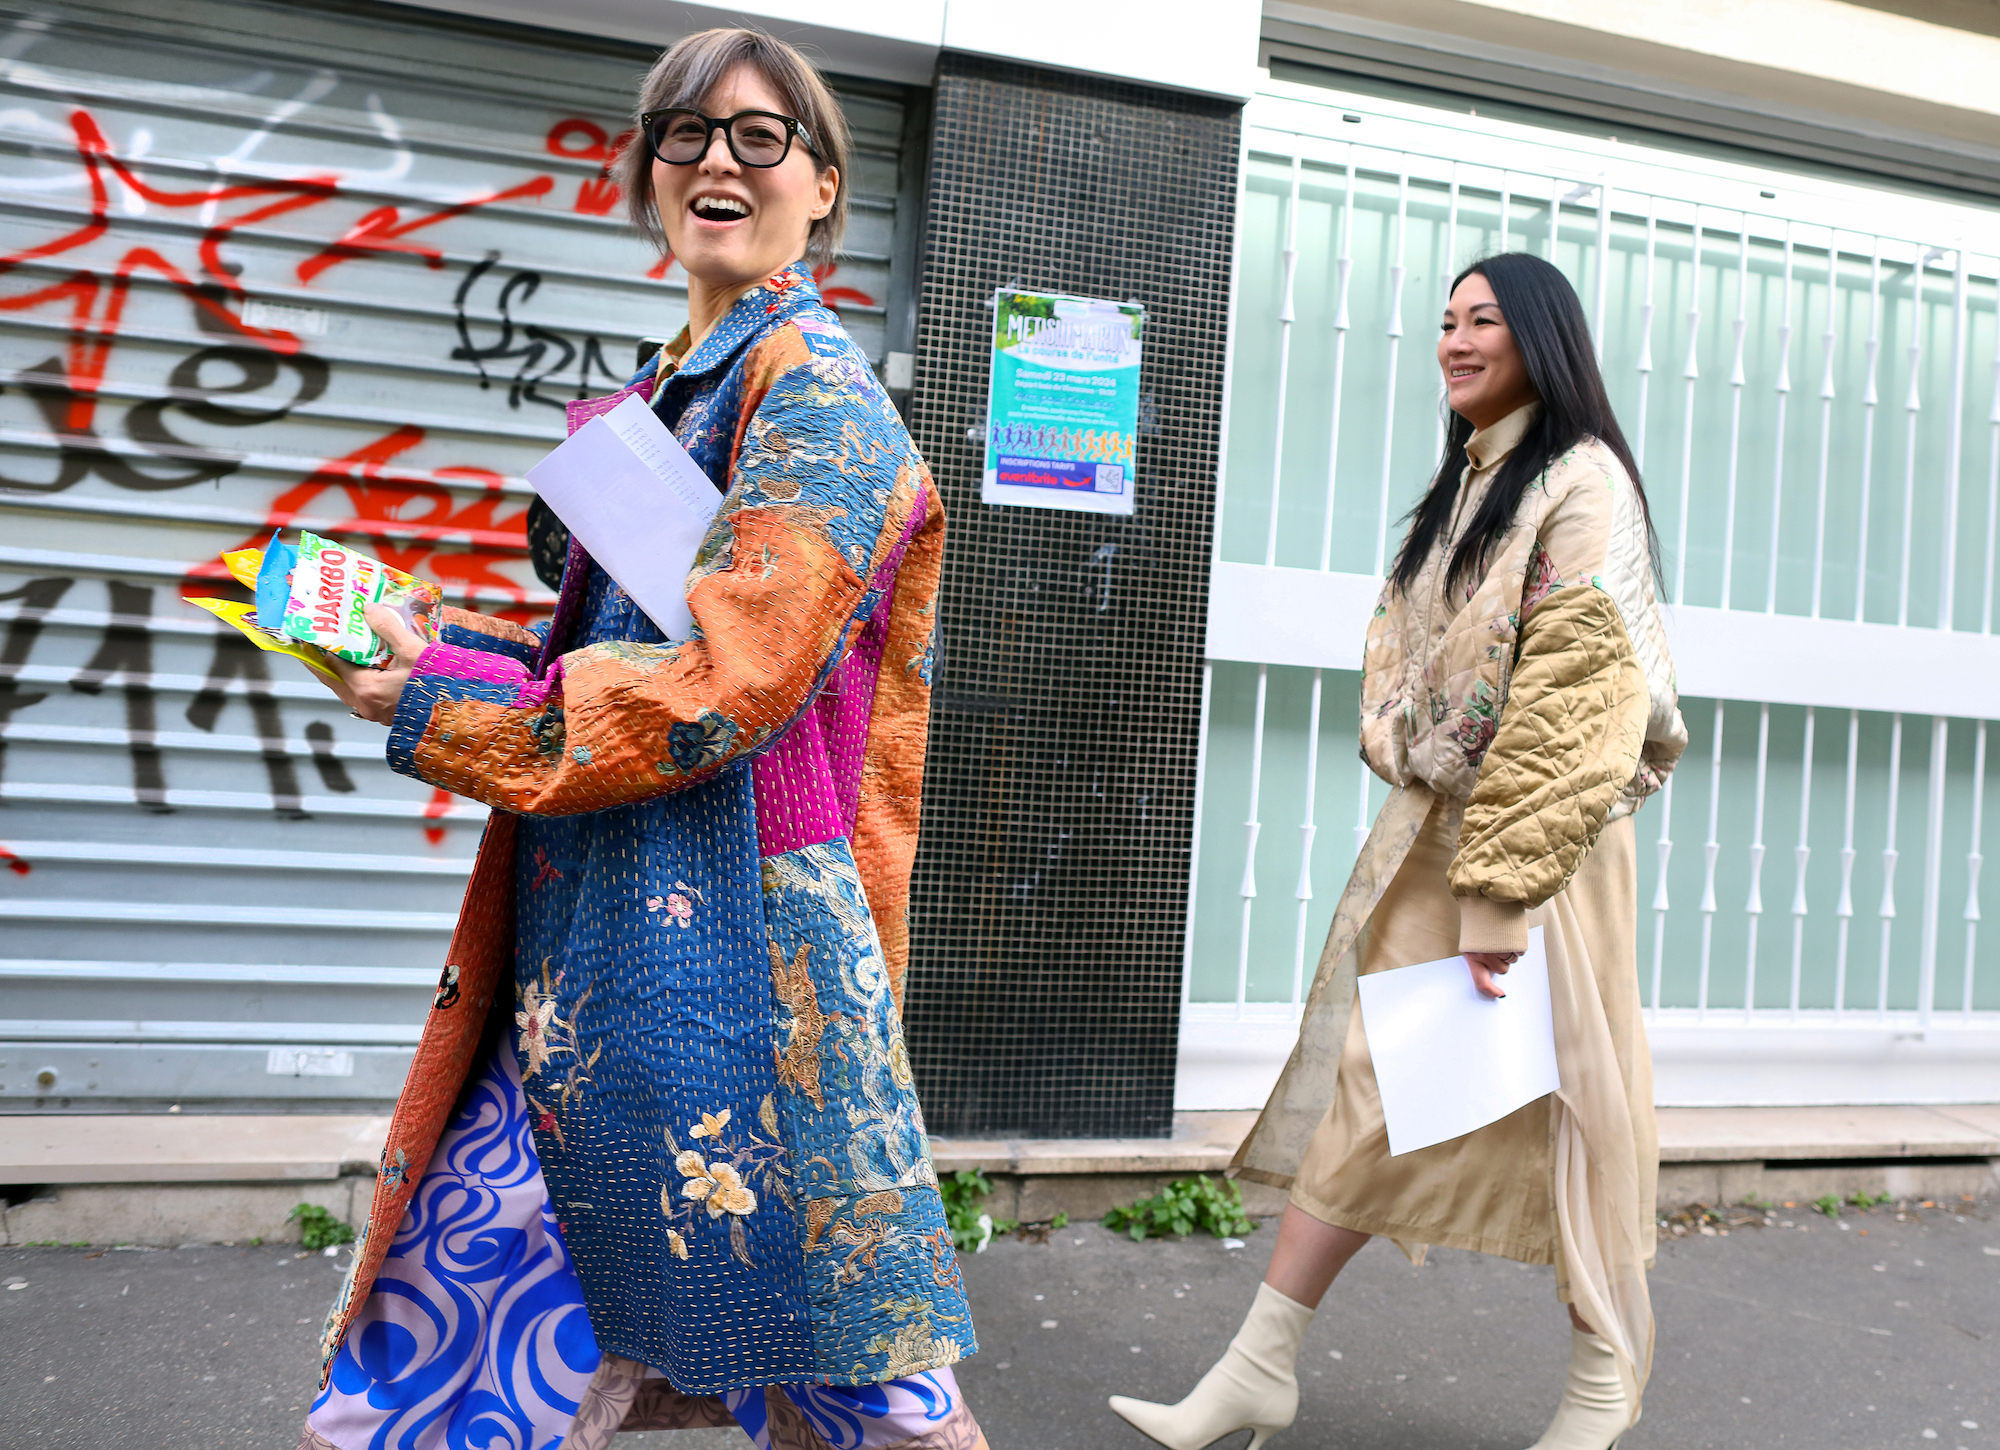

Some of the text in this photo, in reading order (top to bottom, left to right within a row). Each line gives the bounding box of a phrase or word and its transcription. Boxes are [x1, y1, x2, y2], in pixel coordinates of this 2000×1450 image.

[1018, 345, 1029, 354] La
[1032, 347, 1067, 358] course
[1071, 348, 1084, 359] de
[1016, 368, 1116, 387] Samedi 23 mars 2024
[1000, 457, 1076, 471] INSCRIPTIONS TARIFS
[999, 471, 1058, 485] eventbrite
[312, 550, 347, 634] HARIBO
